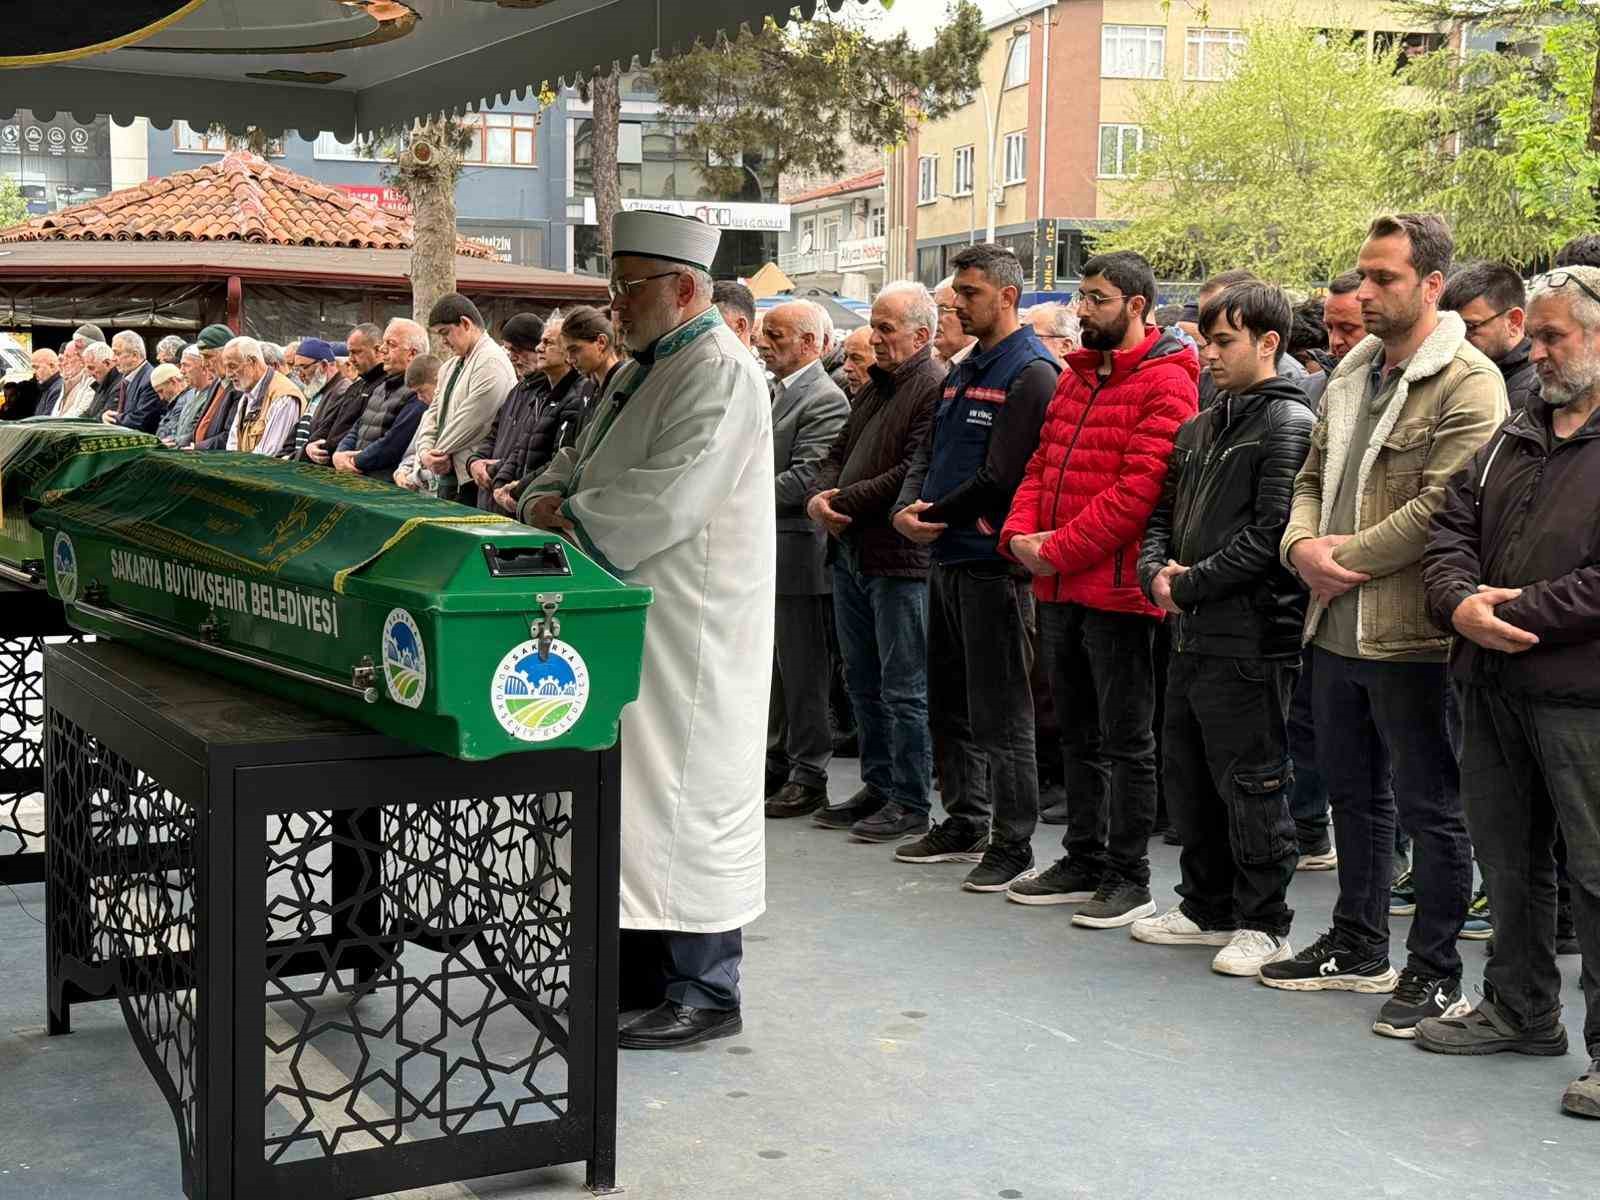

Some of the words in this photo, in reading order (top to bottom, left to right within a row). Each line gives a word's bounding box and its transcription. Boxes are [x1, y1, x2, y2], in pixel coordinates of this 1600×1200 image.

[111, 549, 163, 590] SAKARYA
[164, 559, 249, 613] BÜYÜKŞEHİR
[251, 582, 339, 638] BELEDİYESİ
[512, 643, 575, 662] SAKRYA
